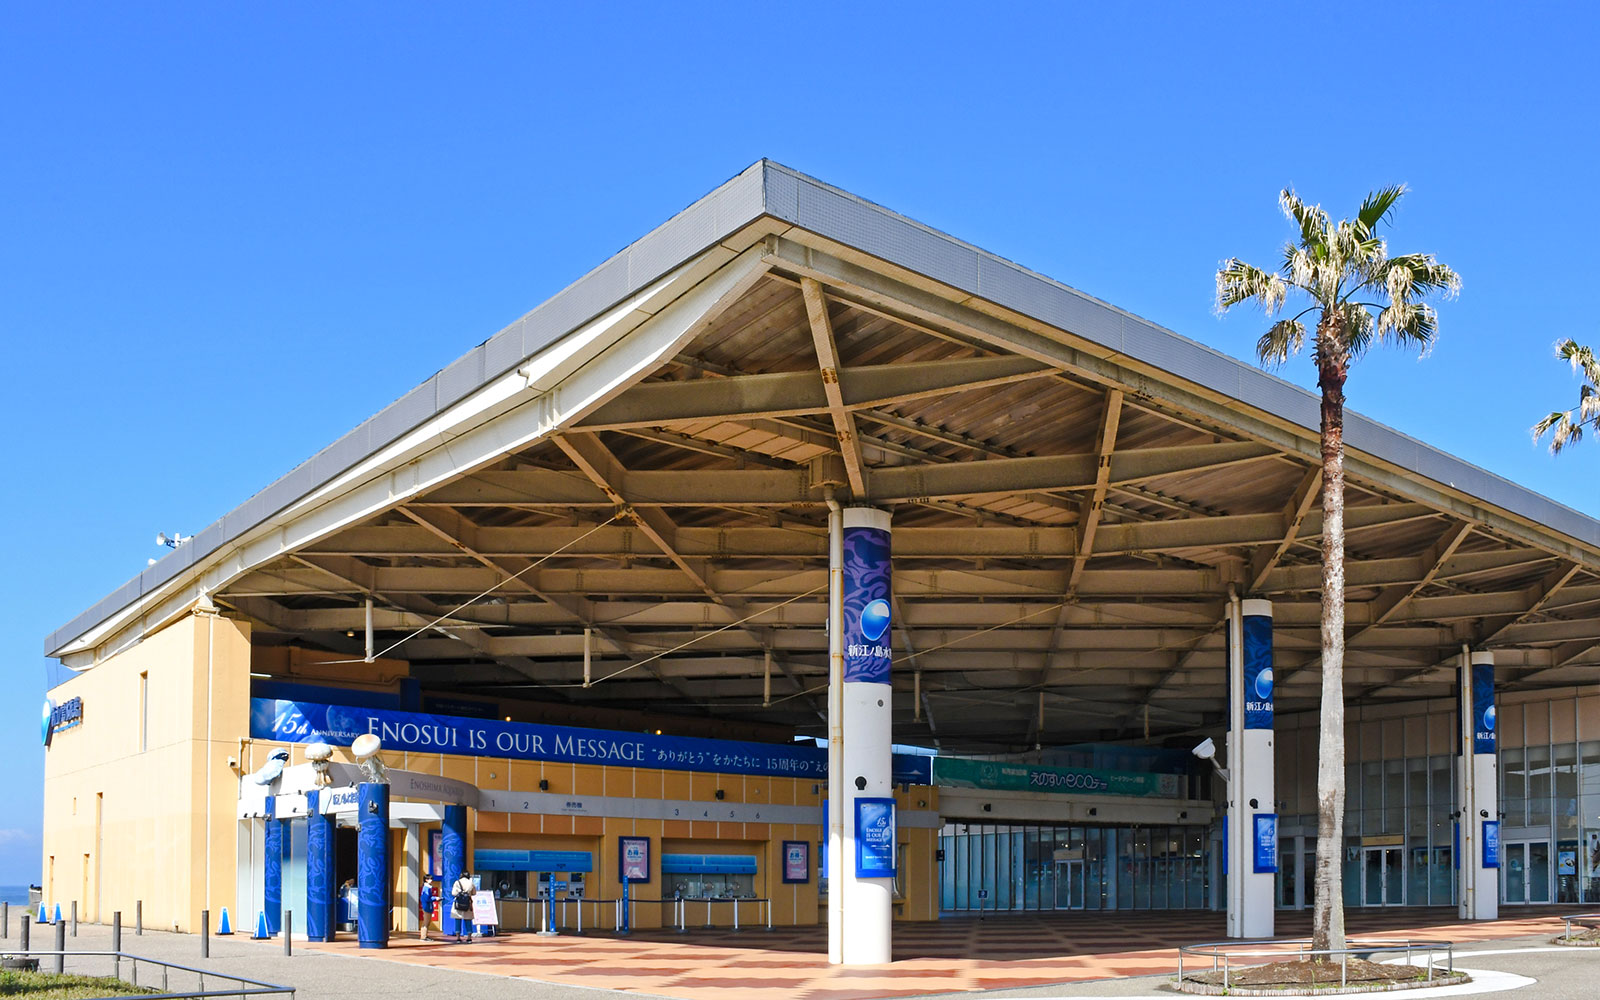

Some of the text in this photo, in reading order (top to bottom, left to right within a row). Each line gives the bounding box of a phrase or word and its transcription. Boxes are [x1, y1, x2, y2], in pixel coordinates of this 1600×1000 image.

[367, 717, 645, 761] ENOSUI IS OUR MESSAGE
[523, 801, 529, 809] 2
[674, 808, 680, 817] 3
[703, 810, 708, 818] 4
[729, 810, 735, 818] 5
